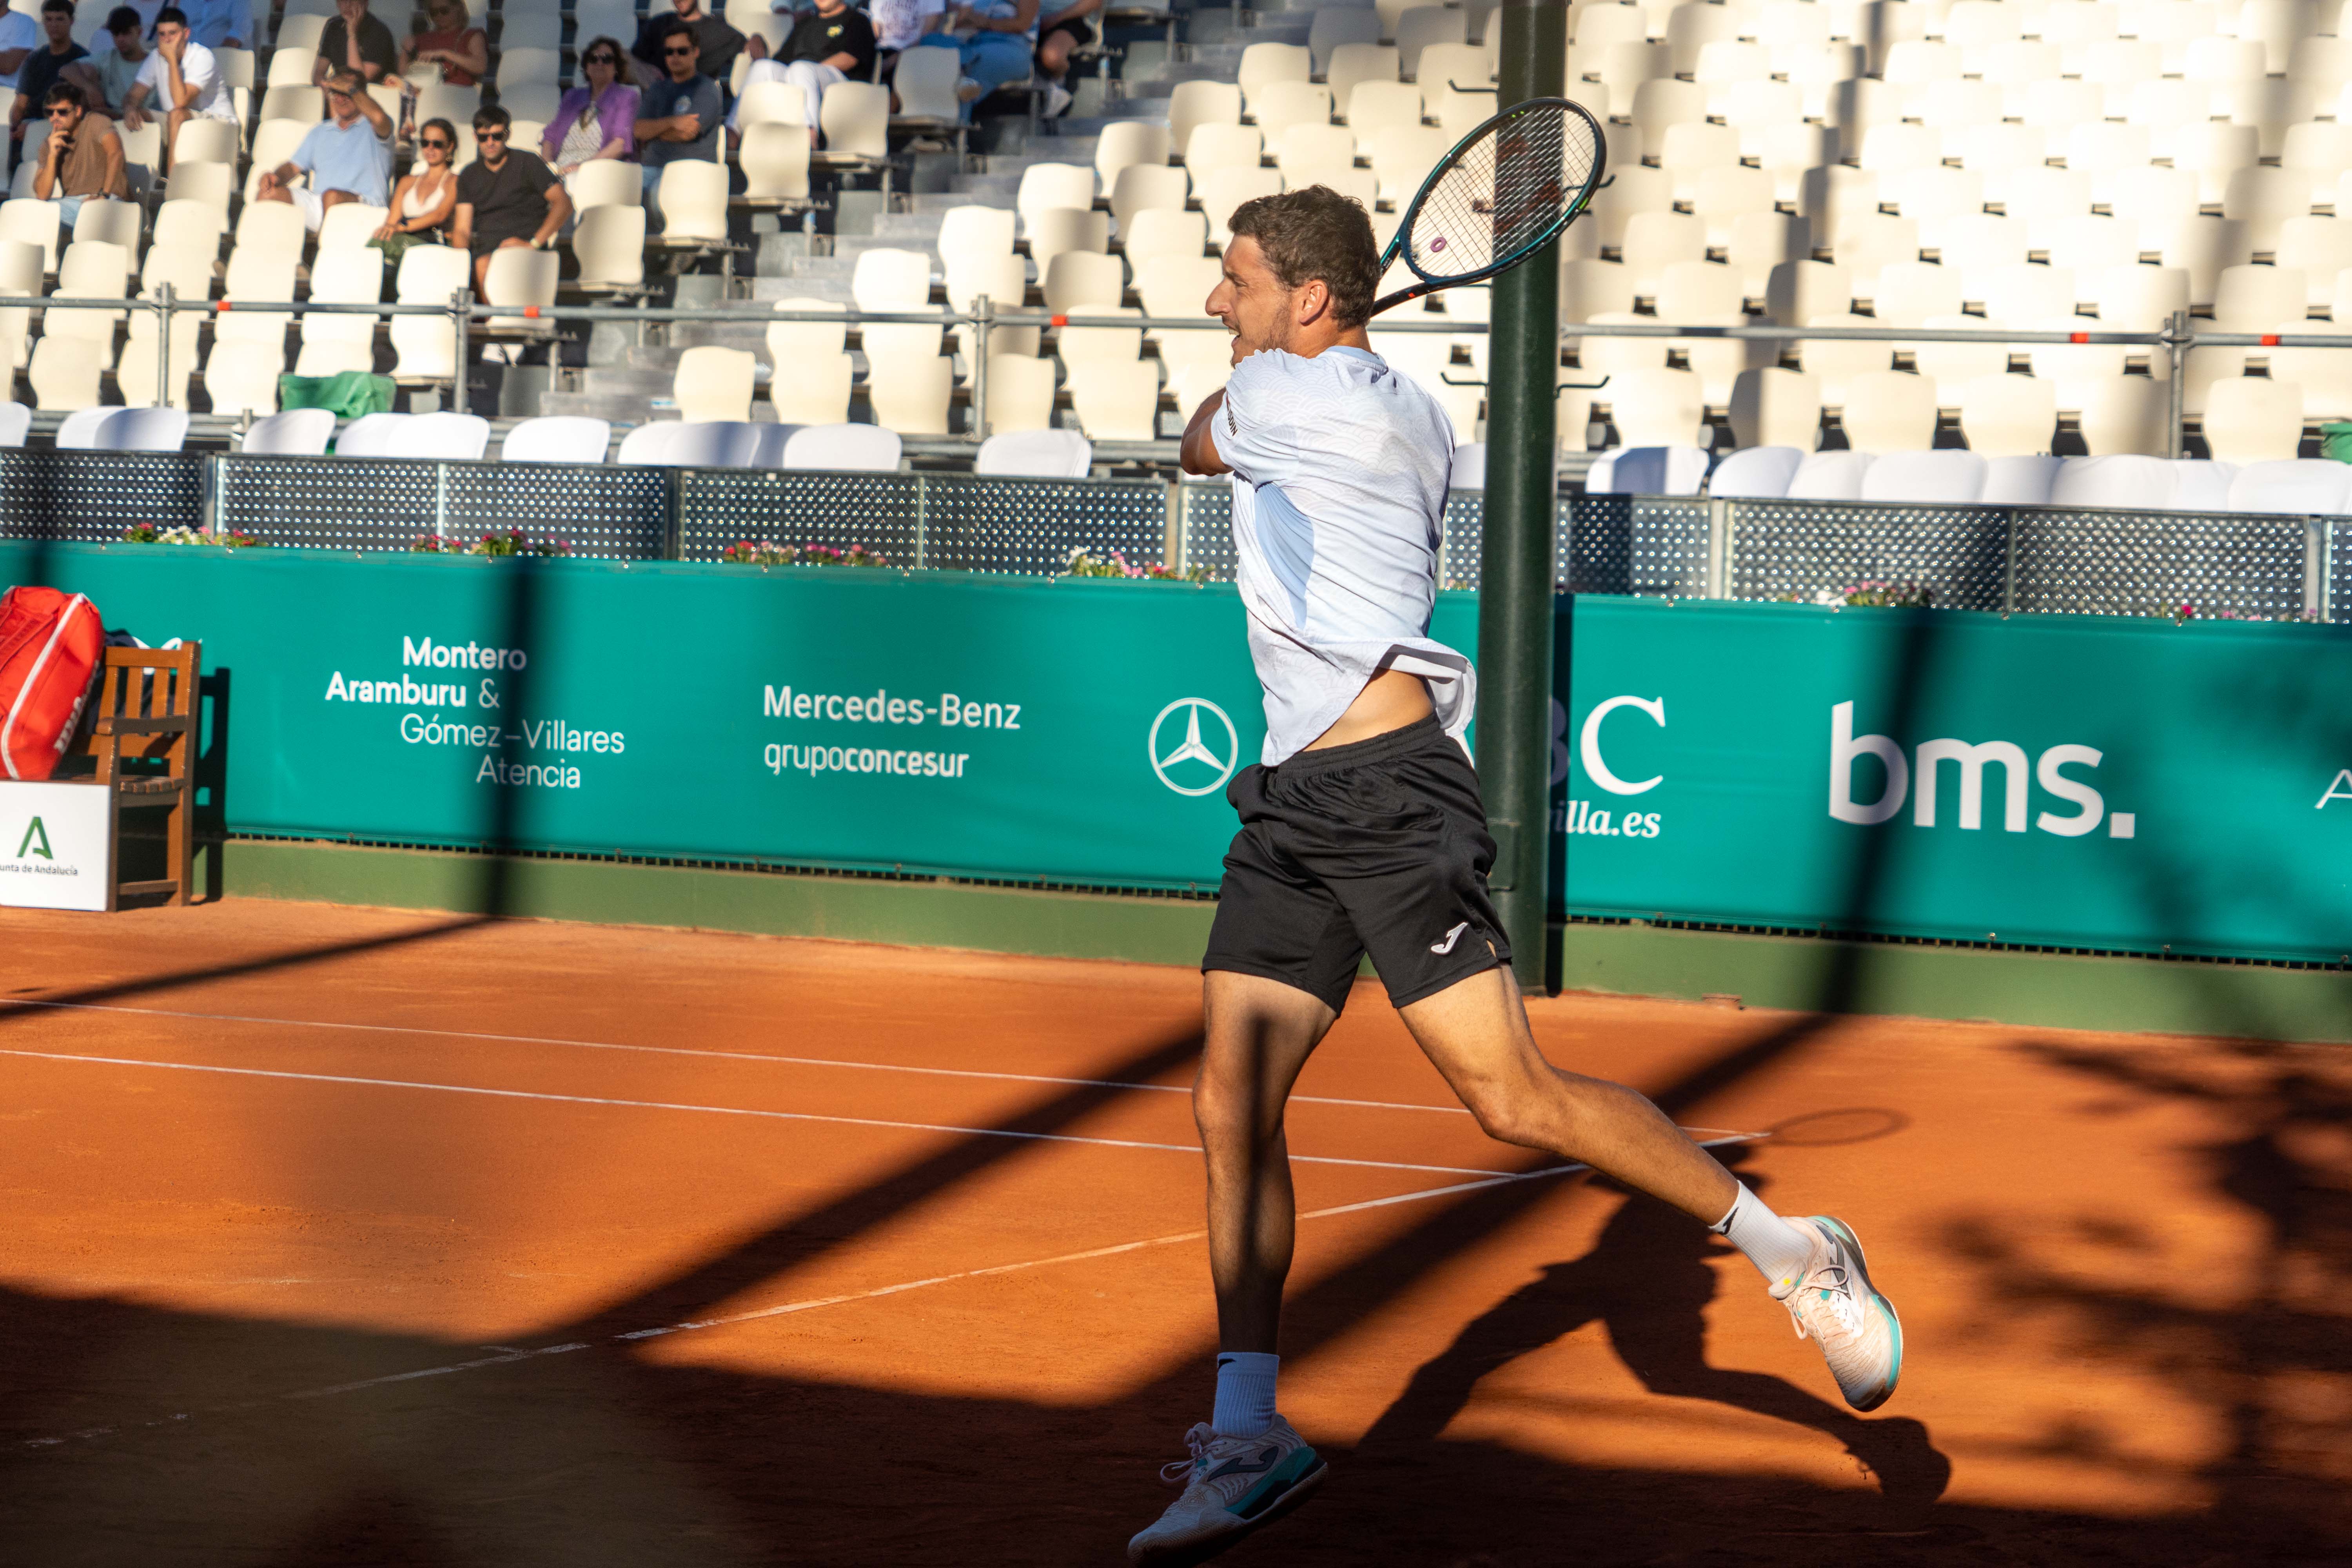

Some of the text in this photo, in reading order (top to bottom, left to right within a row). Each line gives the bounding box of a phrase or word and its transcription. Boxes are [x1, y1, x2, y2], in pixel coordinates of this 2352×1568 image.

[403, 635, 526, 670] Montero
[325, 671, 500, 708] Aramburu &
[764, 684, 1021, 730] Mercedes-Benz
[476, 754, 581, 789] Atencia
[764, 743, 969, 778] grupoconcesur
[1828, 700, 2135, 839] bms.
[1550, 800, 1661, 838] illa.es
[0, 863, 78, 876] unta de Andalucía
